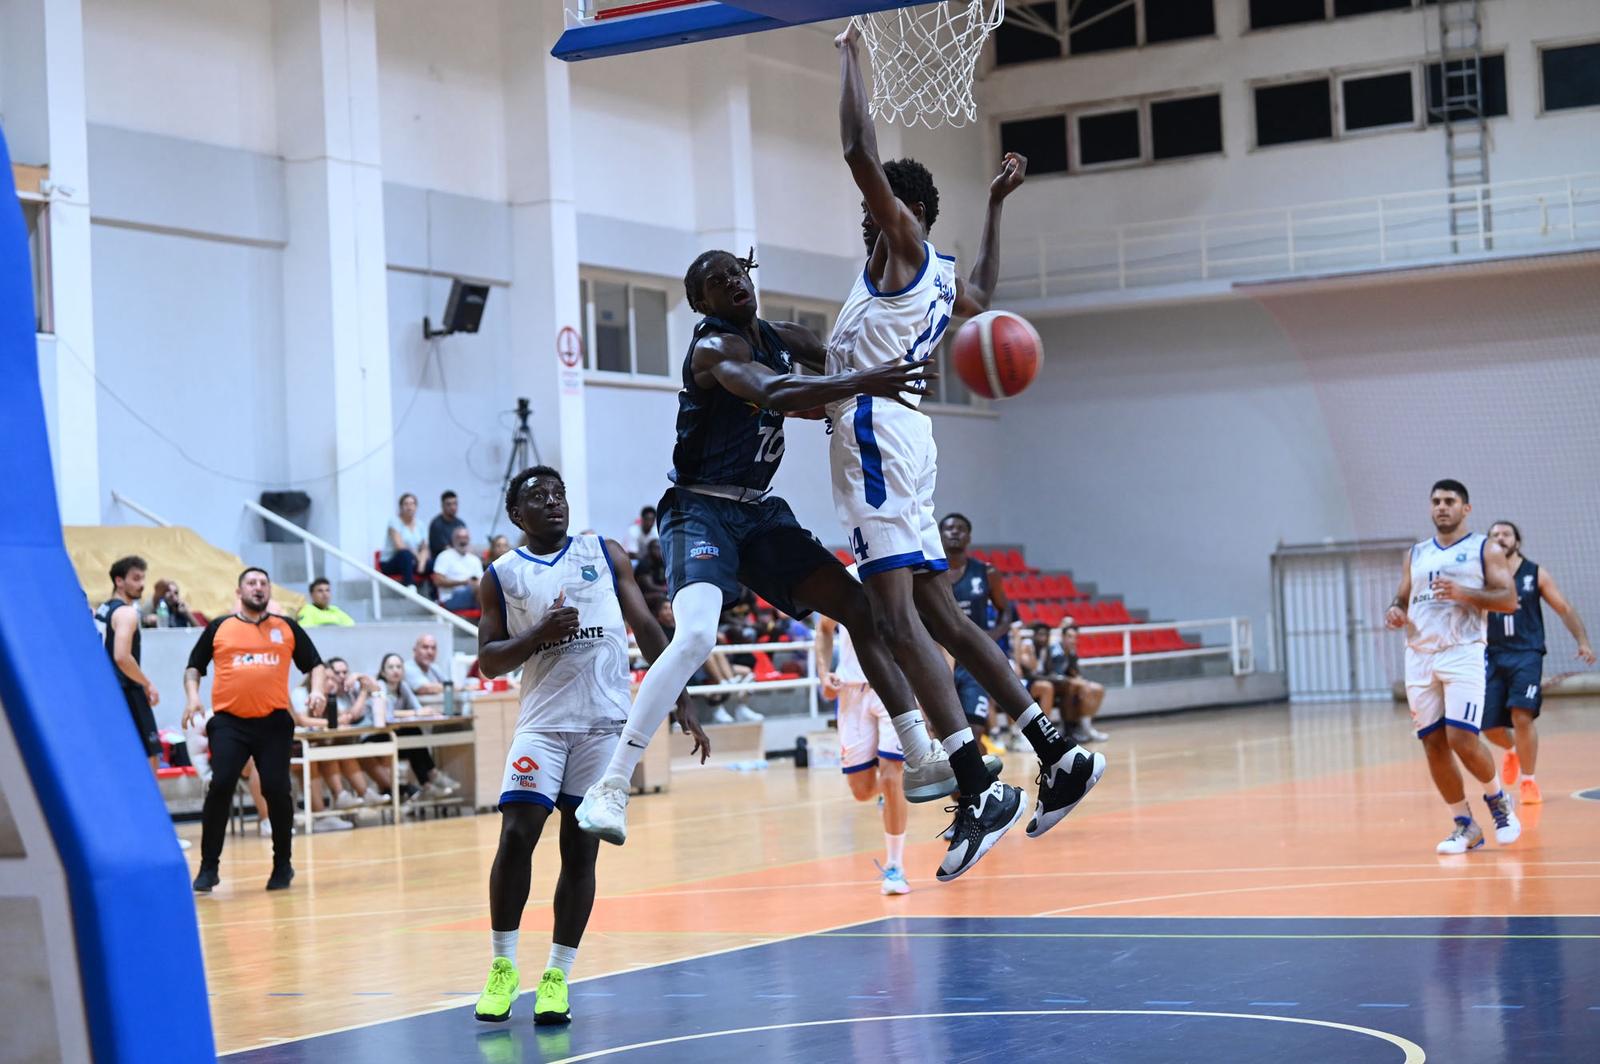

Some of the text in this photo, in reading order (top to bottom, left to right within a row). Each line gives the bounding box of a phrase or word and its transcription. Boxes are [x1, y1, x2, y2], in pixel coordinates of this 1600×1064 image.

[754, 426, 785, 463] 10
[974, 696, 990, 718] 2
[1463, 702, 1478, 723] 11
[511, 774, 534, 785] Cypro
